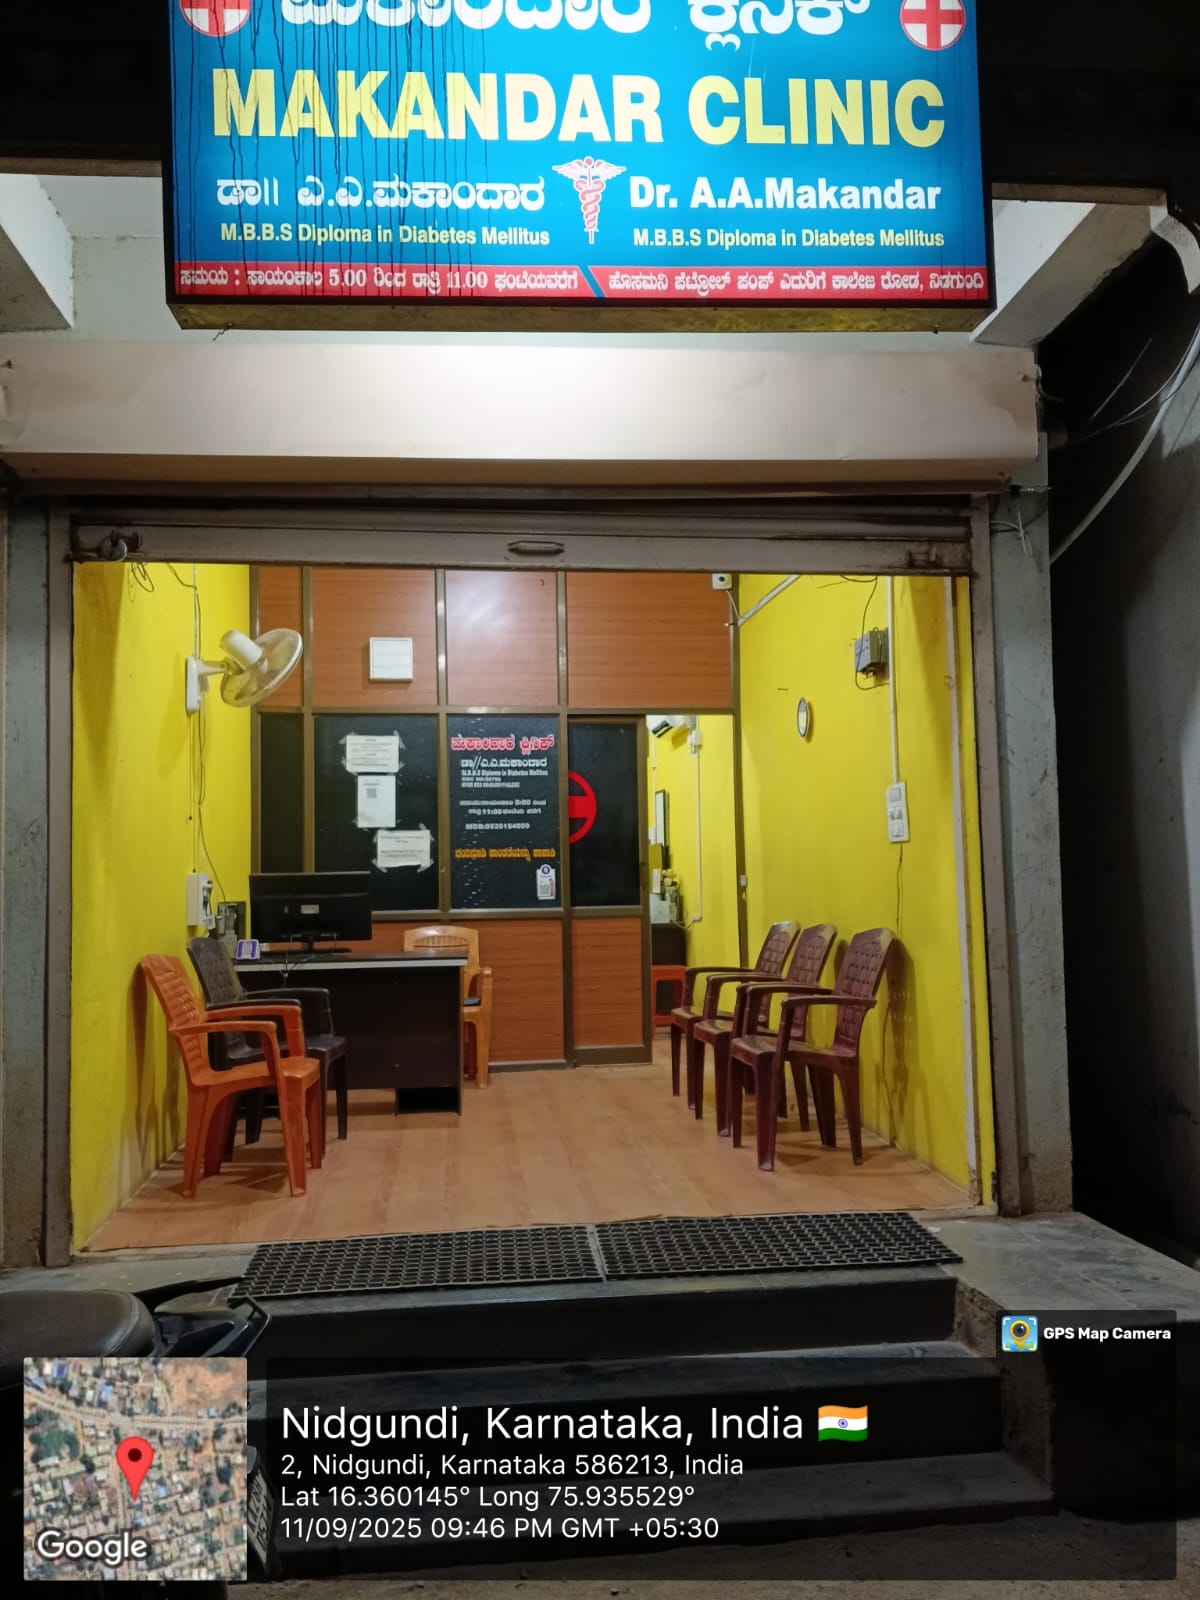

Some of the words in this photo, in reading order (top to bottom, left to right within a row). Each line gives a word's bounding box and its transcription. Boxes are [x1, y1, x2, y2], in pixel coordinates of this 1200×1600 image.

[212, 68, 664, 143] MAKANDAR
[688, 75, 945, 147] CLINIC
[296, 173, 545, 211] ಎ.ಎ.ಮಕಾಂದಾರ
[629, 176, 678, 208] Dr.
[690, 176, 942, 210] A.A.Makandar
[221, 223, 292, 242] M.B.B.S
[298, 224, 372, 246] Diploma
[377, 225, 393, 243] in
[399, 225, 477, 245] Diabetes
[481, 226, 551, 246] Mellitus
[633, 228, 701, 246] M.B.B.S
[706, 228, 776, 250] Diploma
[781, 229, 797, 246] in
[802, 229, 875, 247] Diabetes
[880, 229, 945, 247] Mellitus
[179, 268, 228, 287] ಸಮಯ
[328, 268, 367, 287] 5.00
[445, 270, 489, 289] 11.00
